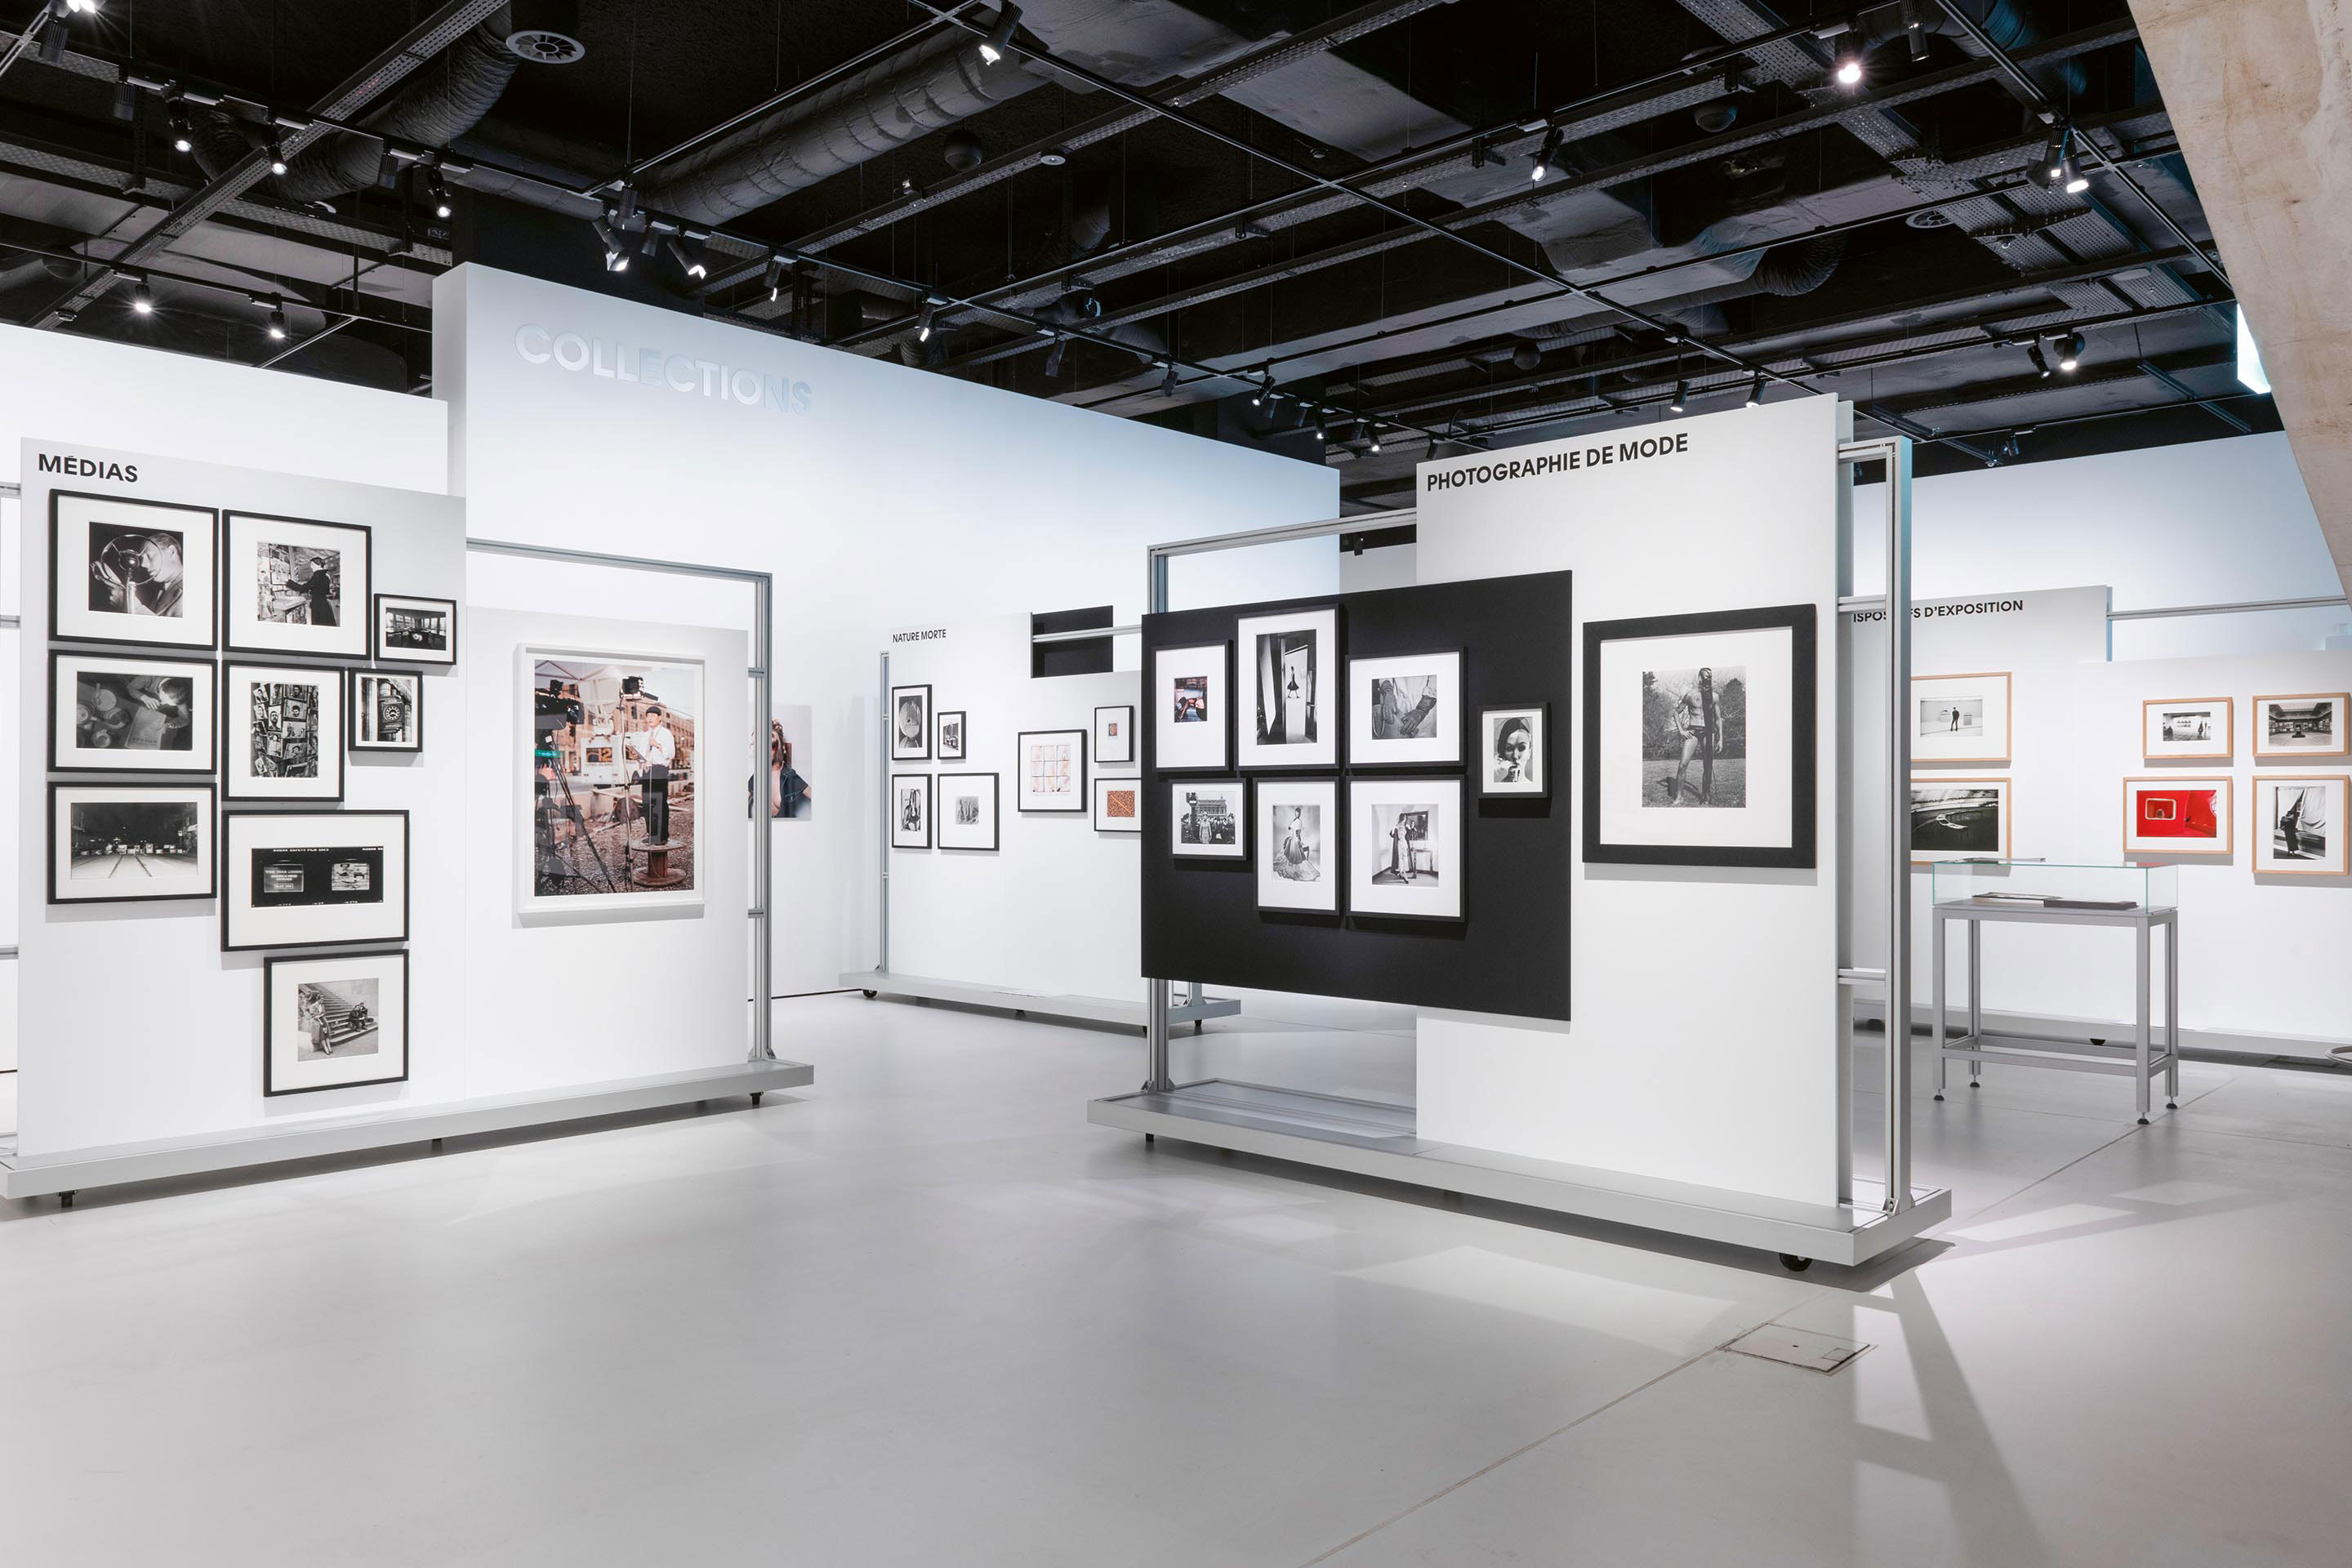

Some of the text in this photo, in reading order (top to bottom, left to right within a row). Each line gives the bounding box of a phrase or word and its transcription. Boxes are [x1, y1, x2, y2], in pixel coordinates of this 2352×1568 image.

[514, 323, 813, 416] COLLECTIONS
[38, 453, 138, 483] MÉDIAS
[1428, 433, 1688, 492] PHOTOGRAPHIE DE MODE
[1924, 600, 2023, 617] D'EXPOSITION
[893, 629, 947, 643] NATURE MORTE
